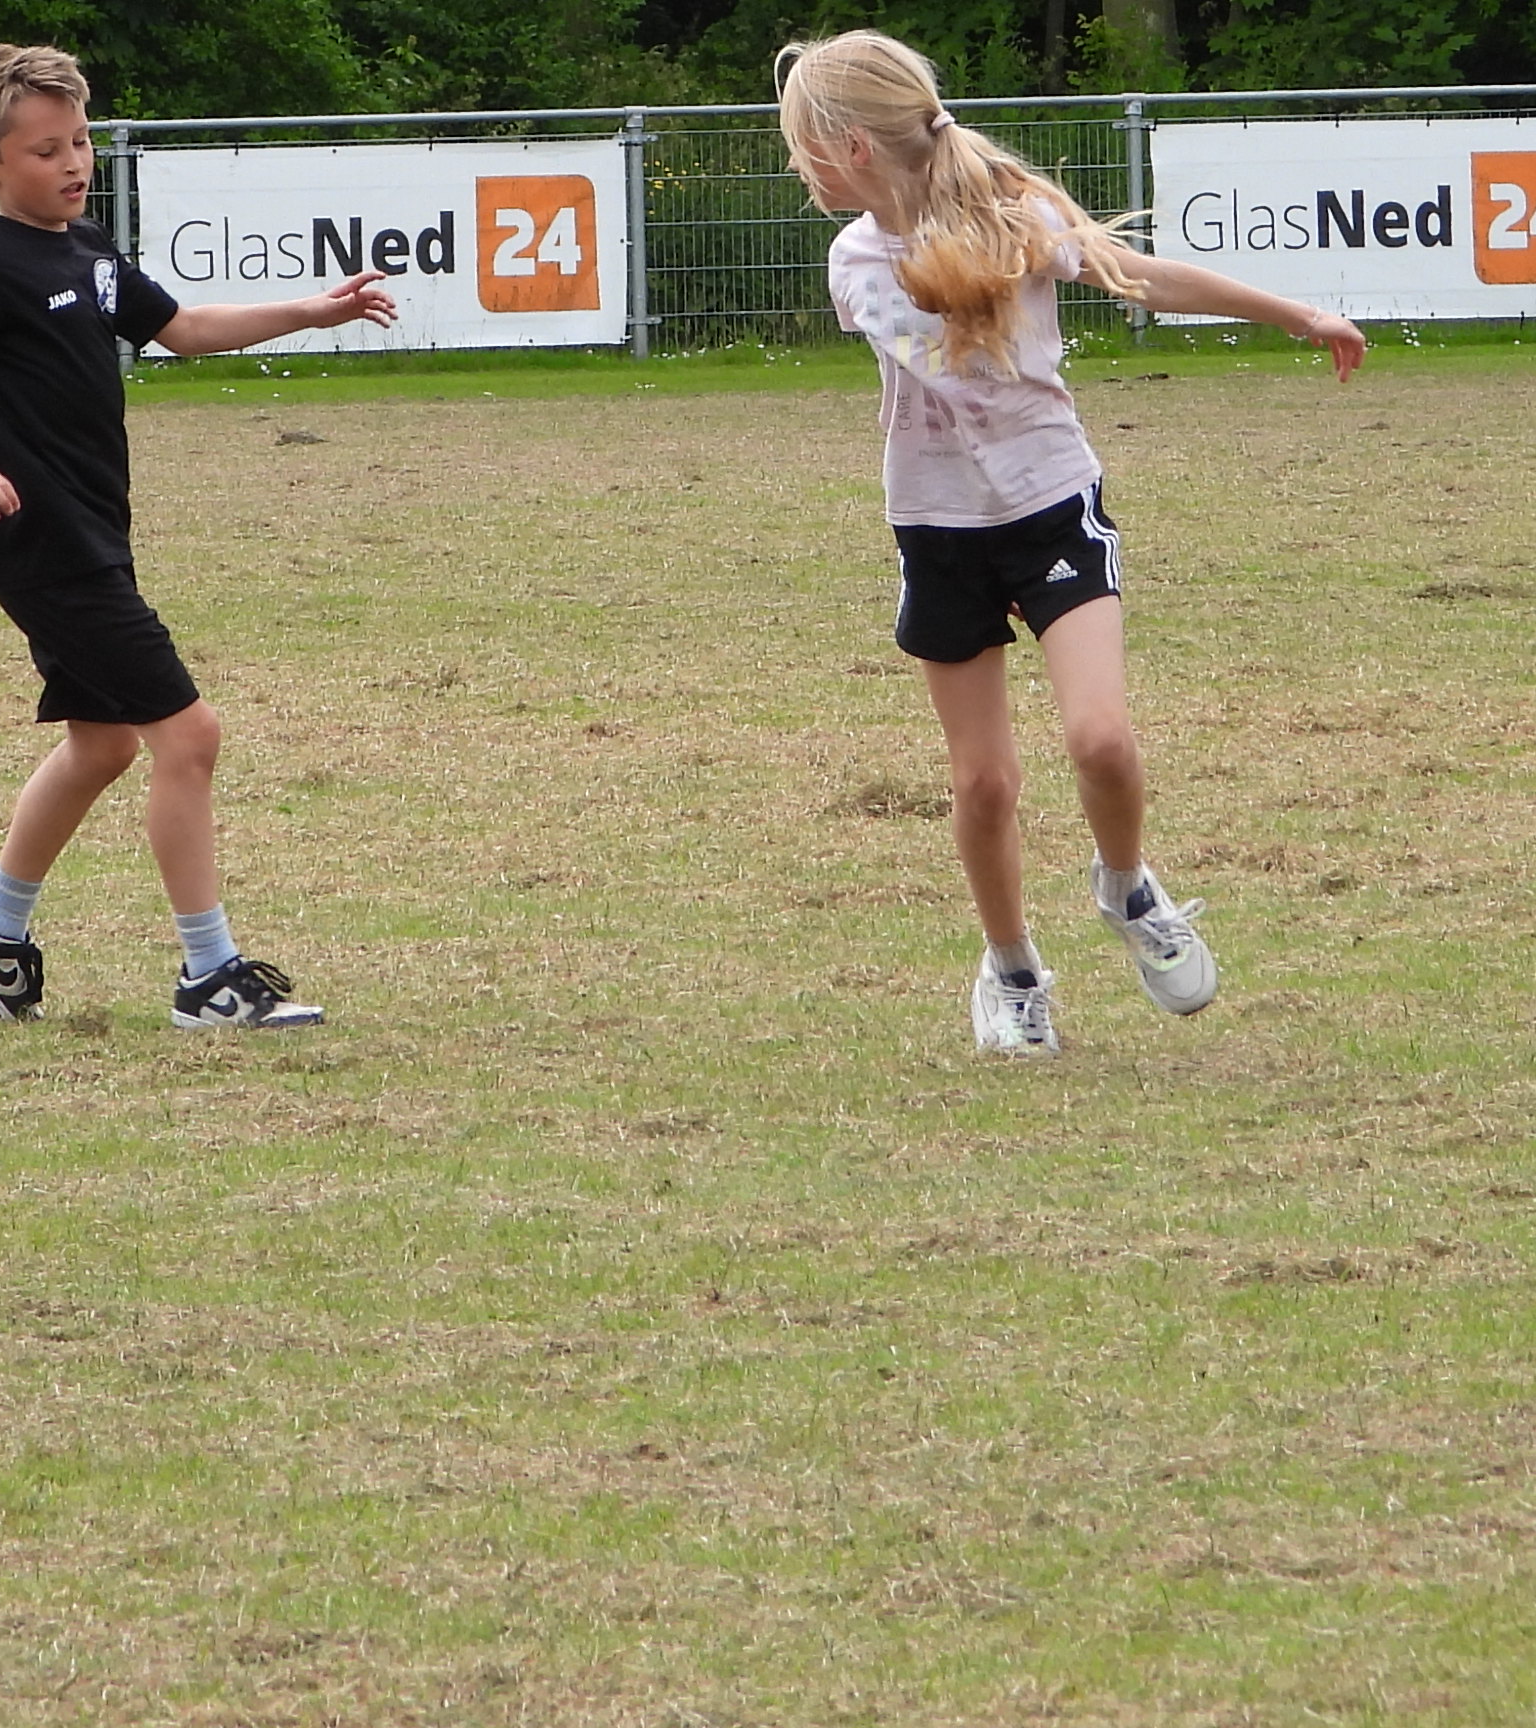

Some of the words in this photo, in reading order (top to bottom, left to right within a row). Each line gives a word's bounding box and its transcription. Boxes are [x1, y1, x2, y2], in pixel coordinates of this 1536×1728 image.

[171, 211, 455, 281] GlasNed
[494, 208, 581, 276] 24
[1182, 185, 1452, 252] GlasNed
[48, 289, 77, 310] JAKO
[897, 392, 911, 430] CARE
